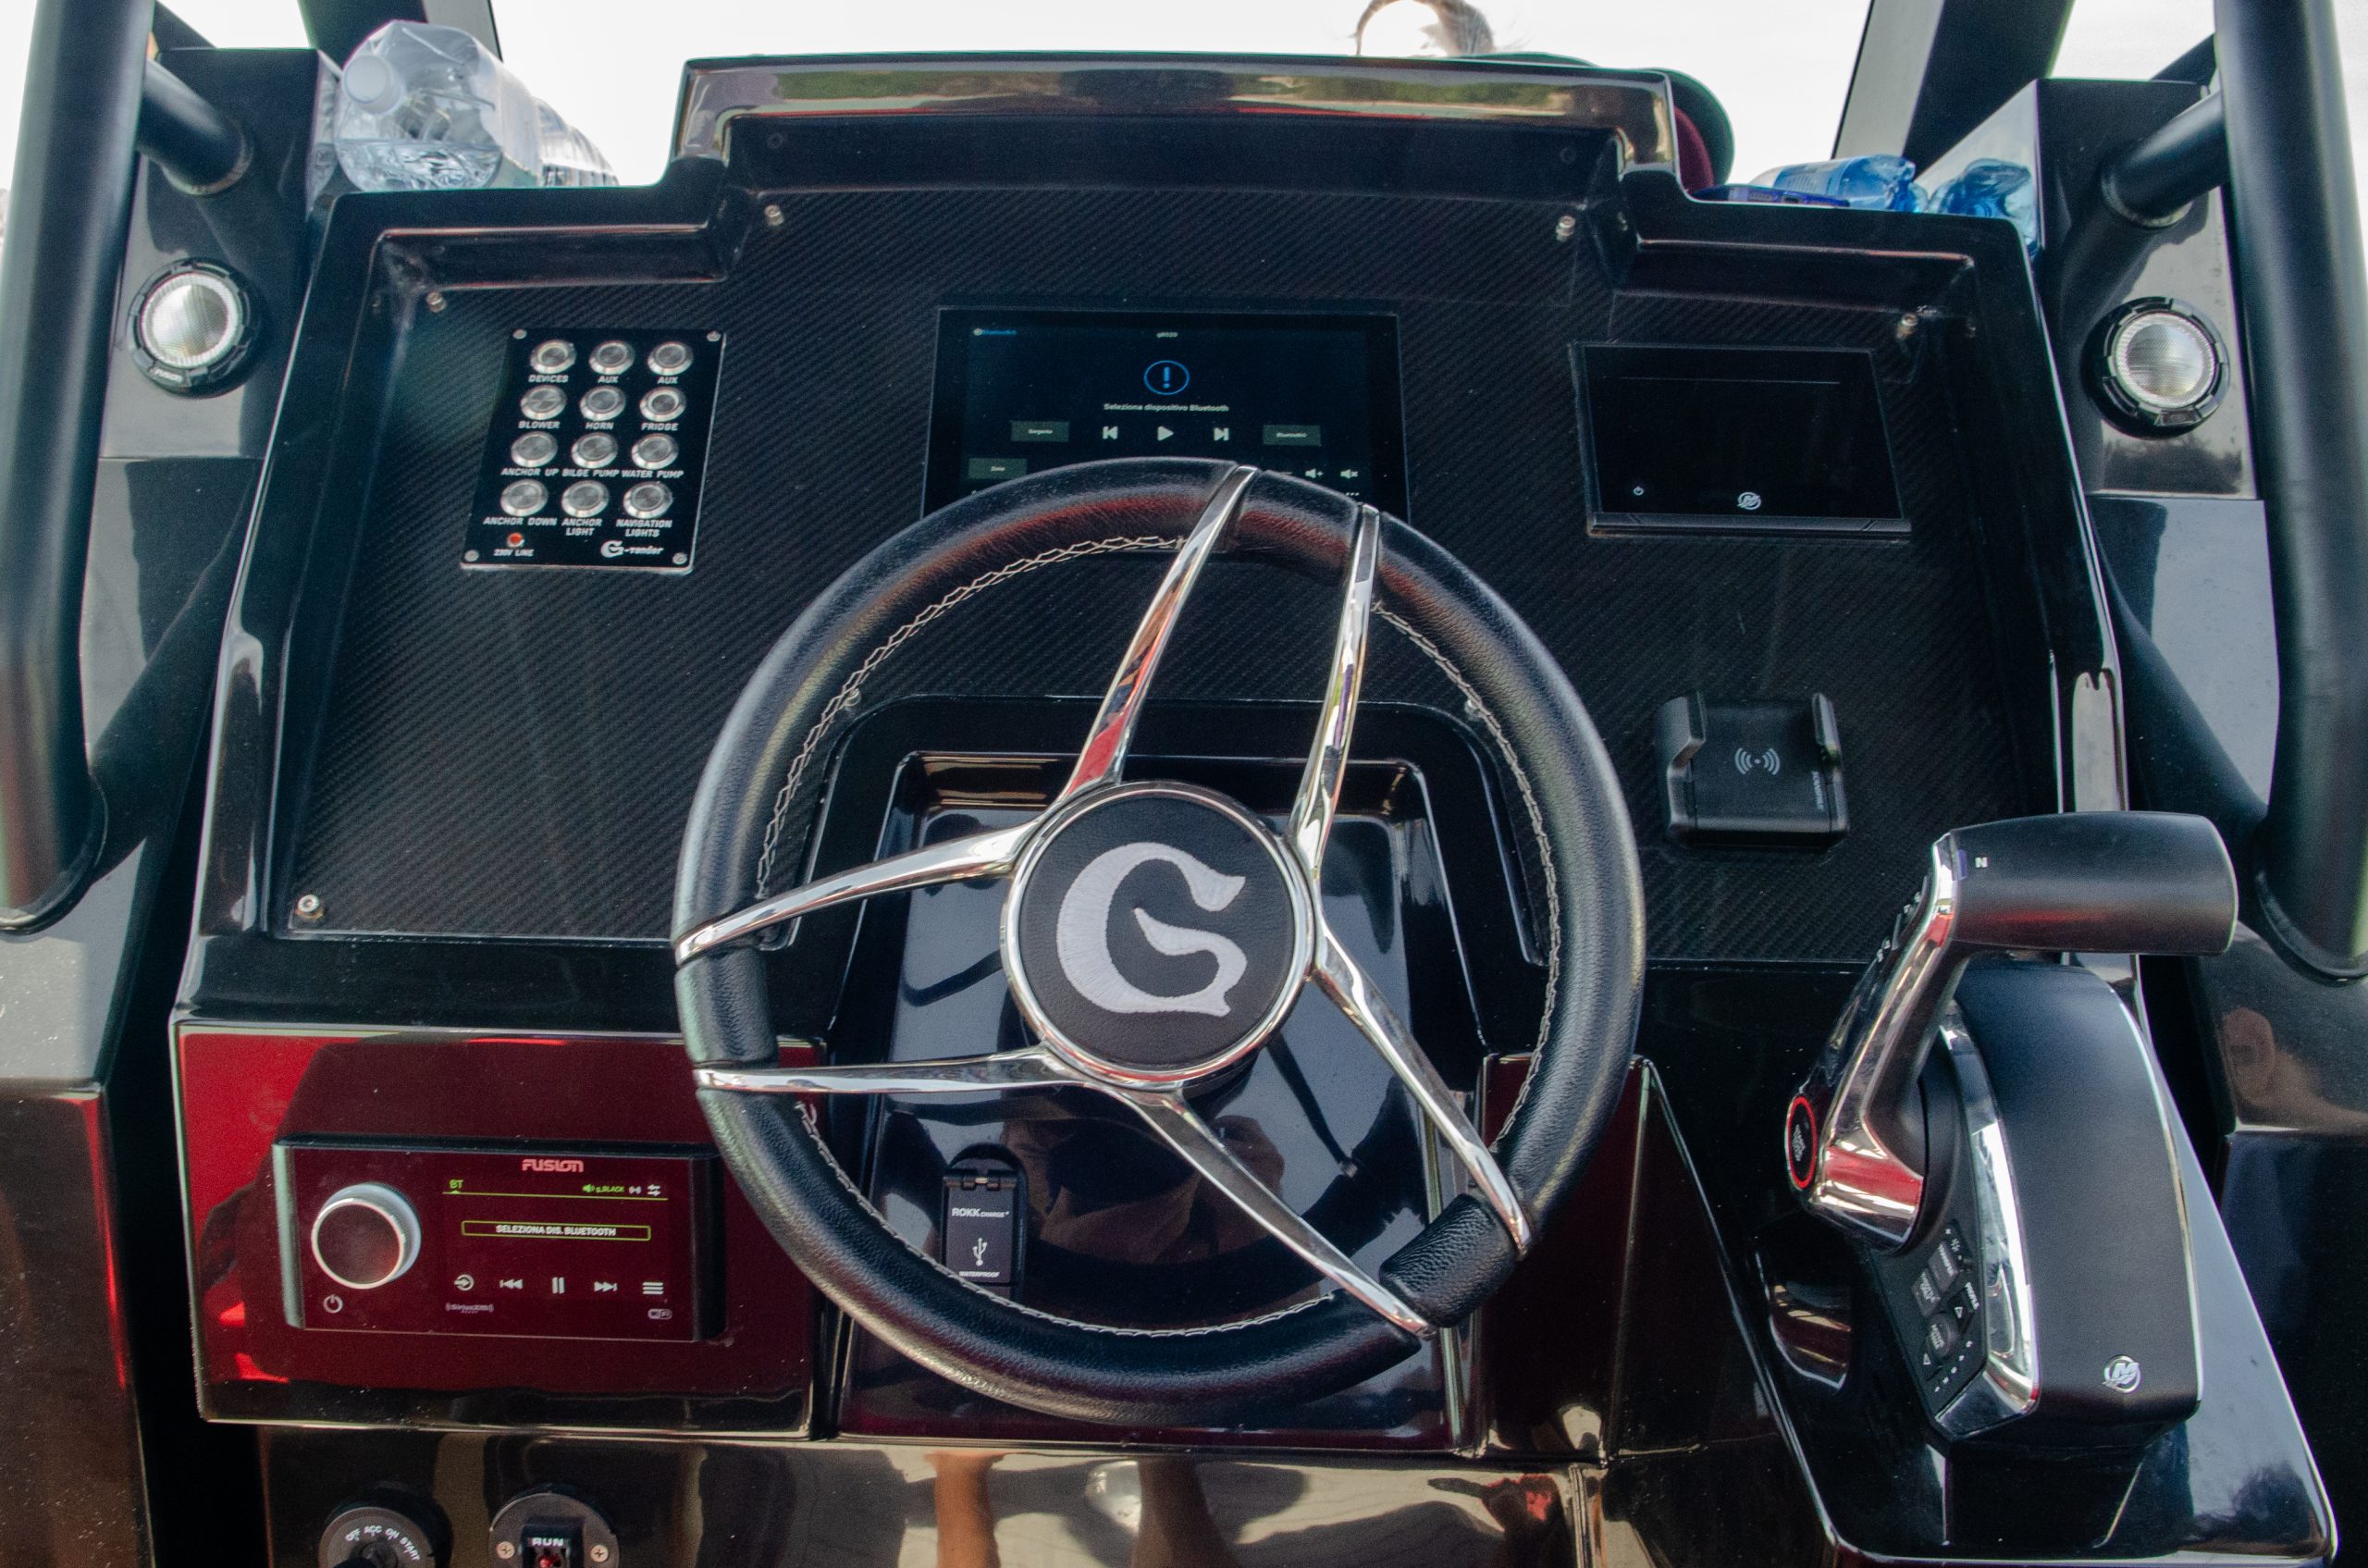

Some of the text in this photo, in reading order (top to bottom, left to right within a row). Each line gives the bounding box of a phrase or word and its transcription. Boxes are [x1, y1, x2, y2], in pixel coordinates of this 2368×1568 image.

[528, 375, 569, 383] DEVICES
[598, 376, 619, 384] AUX
[658, 377, 678, 385] AUX
[518, 421, 561, 429] BLOWER
[586, 422, 614, 430] HORN
[641, 423, 679, 431] FRIDGE
[501, 468, 559, 476] ANCHOR UP
[561, 469, 620, 477] BILGE PUMP
[622, 470, 684, 478] WATER PUMP
[483, 517, 557, 525] ANCHOR DOWN
[561, 518, 602, 527] ANCHOR
[616, 519, 672, 528] NAVIGATION
[566, 527, 595, 536] LIGHT
[625, 528, 660, 537] LIGHTS
[522, 1159, 584, 1172] FUSION
[450, 1179, 463, 1189] BT
[952, 1208, 979, 1216] ROKK
[496, 1225, 617, 1236] SELEZIONA DIS. BLUETOOTH
[385, 1527, 400, 1540] ON
[531, 1537, 564, 1547] RUN
